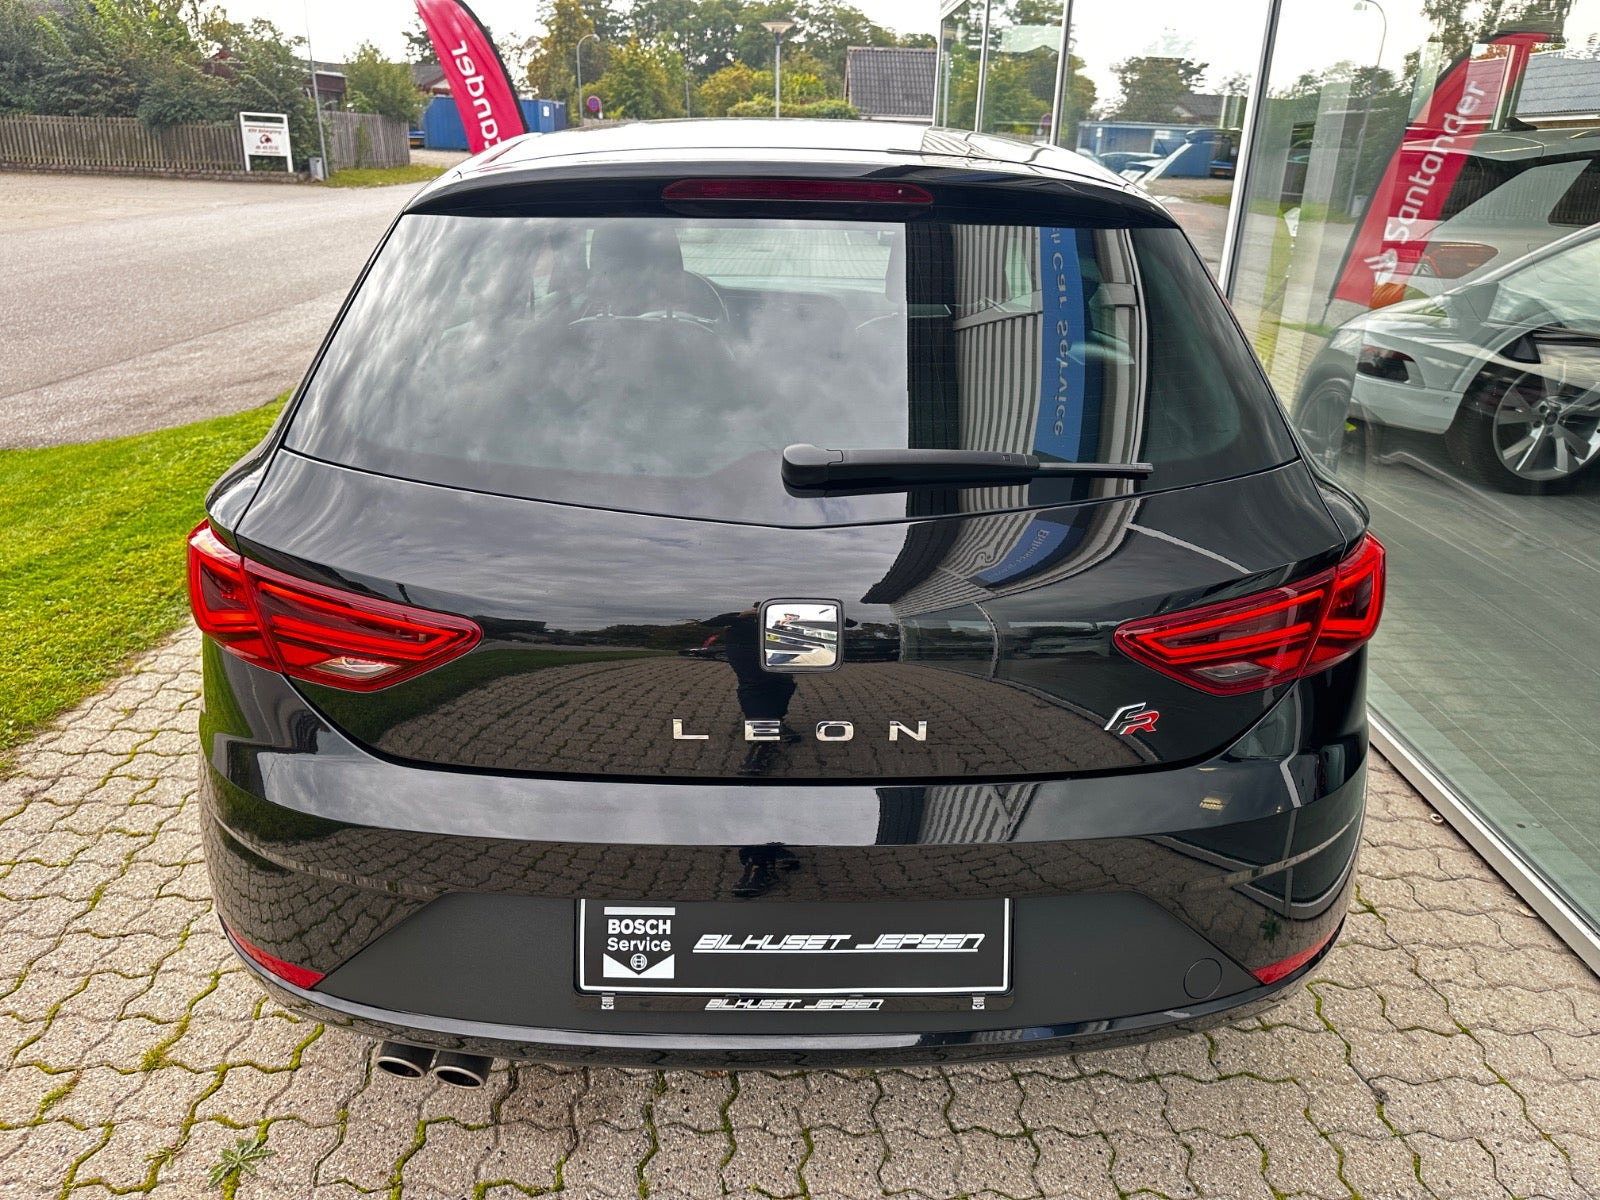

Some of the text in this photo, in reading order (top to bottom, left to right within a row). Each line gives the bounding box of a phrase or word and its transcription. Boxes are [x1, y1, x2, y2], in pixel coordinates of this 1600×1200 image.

[1384, 80, 1485, 244] Santander
[1103, 702, 1160, 735] FR
[672, 718, 927, 742] LEON
[607, 918, 671, 935] BOSCH
[606, 936, 672, 952] Service
[694, 933, 986, 950] BILHUSET JEPSEN
[705, 999, 885, 1009] BILHUSET JEPSEN
